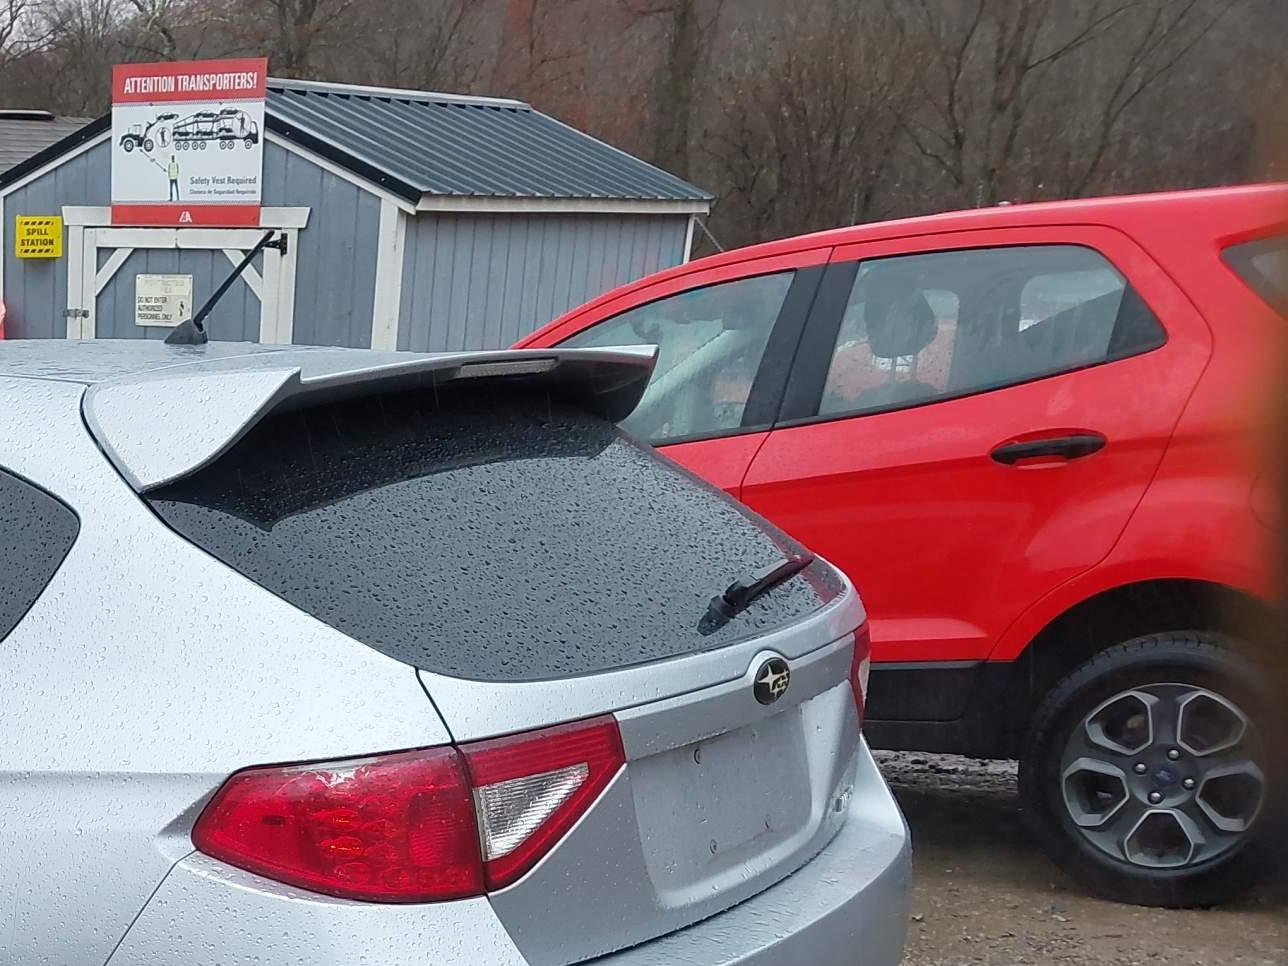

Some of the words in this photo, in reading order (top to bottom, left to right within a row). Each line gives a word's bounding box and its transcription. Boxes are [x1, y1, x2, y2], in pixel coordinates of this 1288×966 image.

[123, 76, 175, 94] ATTENTION
[177, 71, 258, 92] TRANSPORTERS!
[190, 176, 210, 186] Safety
[211, 176, 226, 185] Vest
[227, 175, 257, 186] Required
[26, 228, 49, 236] SPILL
[21, 238, 54, 247] STATION
